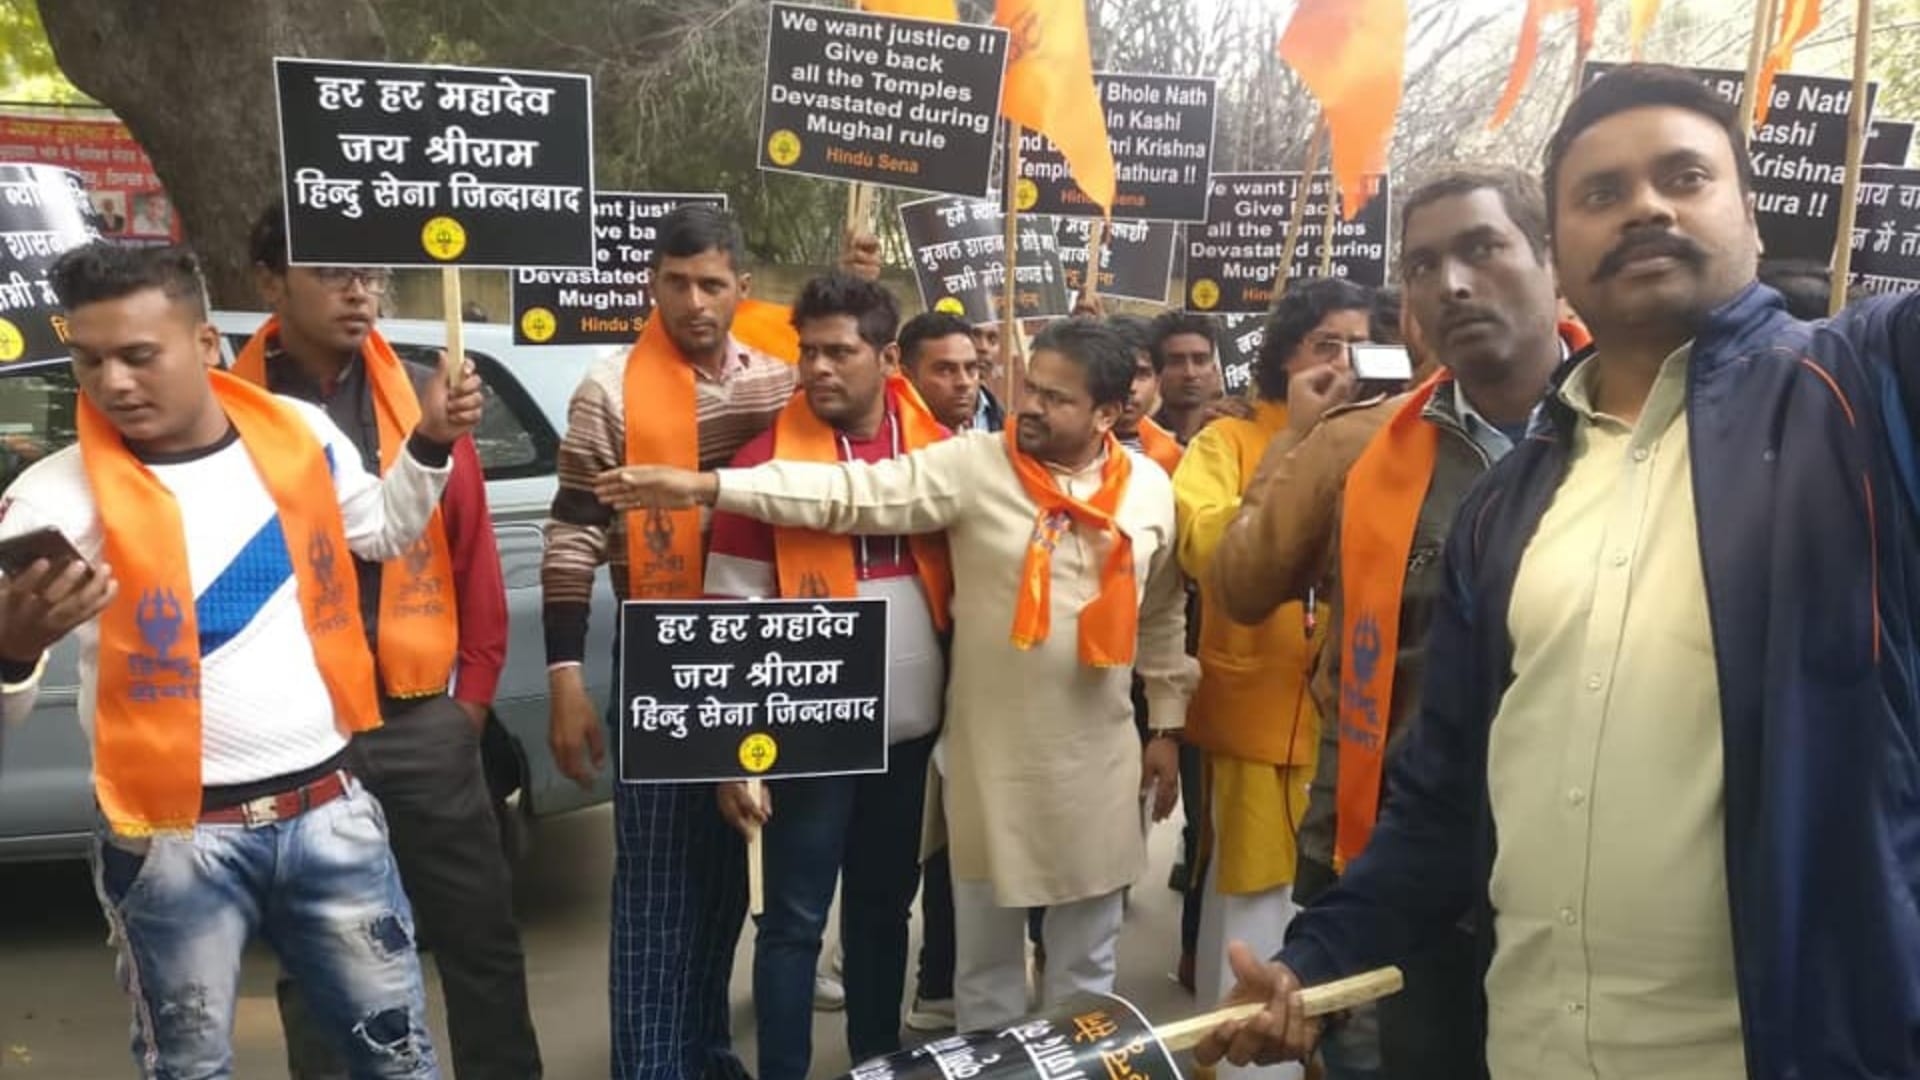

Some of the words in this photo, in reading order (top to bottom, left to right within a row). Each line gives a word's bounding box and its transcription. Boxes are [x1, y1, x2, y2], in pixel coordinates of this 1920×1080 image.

[781, 10, 818, 32] We
[825, 18, 882, 41] want
[887, 23, 971, 50] justice
[979, 33, 996, 54] !!
[825, 42, 878, 65] Give
[886, 50, 944, 73] back
[314, 76, 366, 110] हर
[375, 80, 426, 112] हर
[435, 75, 556, 115] महादेव
[791, 65, 819, 83] all
[827, 68, 863, 88] the
[872, 72, 972, 102] Temples
[1107, 82, 1160, 104] Bhole
[1165, 85, 1208, 107] Nath
[1716, 79, 1790, 109] Bhle
[771, 84, 903, 118] Devastated
[910, 102, 990, 134] during
[1107, 110, 1124, 128] in
[1129, 111, 1181, 131] Kashi
[806, 114, 892, 141] Mughal
[900, 128, 946, 149] rule
[337, 133, 411, 163] जय
[424, 125, 540, 168] श्रीराम
[1019, 134, 1041, 152] nd
[1106, 135, 1132, 156] hri
[1136, 137, 1207, 159] Krishna
[826, 147, 873, 168] Hindu
[878, 152, 919, 173] Sena
[1018, 157, 1071, 183] Templ
[1114, 162, 1179, 185] athura
[371, 171, 441, 207] सेना
[448, 172, 584, 213] जिन्दाबाद
[1233, 179, 1286, 196] want
[1235, 201, 1284, 217] Give
[1807, 192, 1829, 218] !!
[595, 226, 622, 240] ve
[629, 222, 657, 240] ba
[1207, 221, 1231, 237] all
[1238, 222, 1273, 237] the
[1191, 242, 1309, 259] Devastatd
[519, 266, 649, 284] Devastated
[1308, 263, 1348, 277] rle
[559, 289, 644, 309] Mughal
[581, 317, 628, 332] Hindu
[655, 614, 699, 644] हर
[708, 613, 750, 643] हर
[758, 604, 860, 641] महादेव
[672, 662, 735, 690] जय
[746, 652, 844, 688] श्रीराम
[697, 696, 759, 728] सेना
[766, 692, 879, 726] जिन्दाबाद
